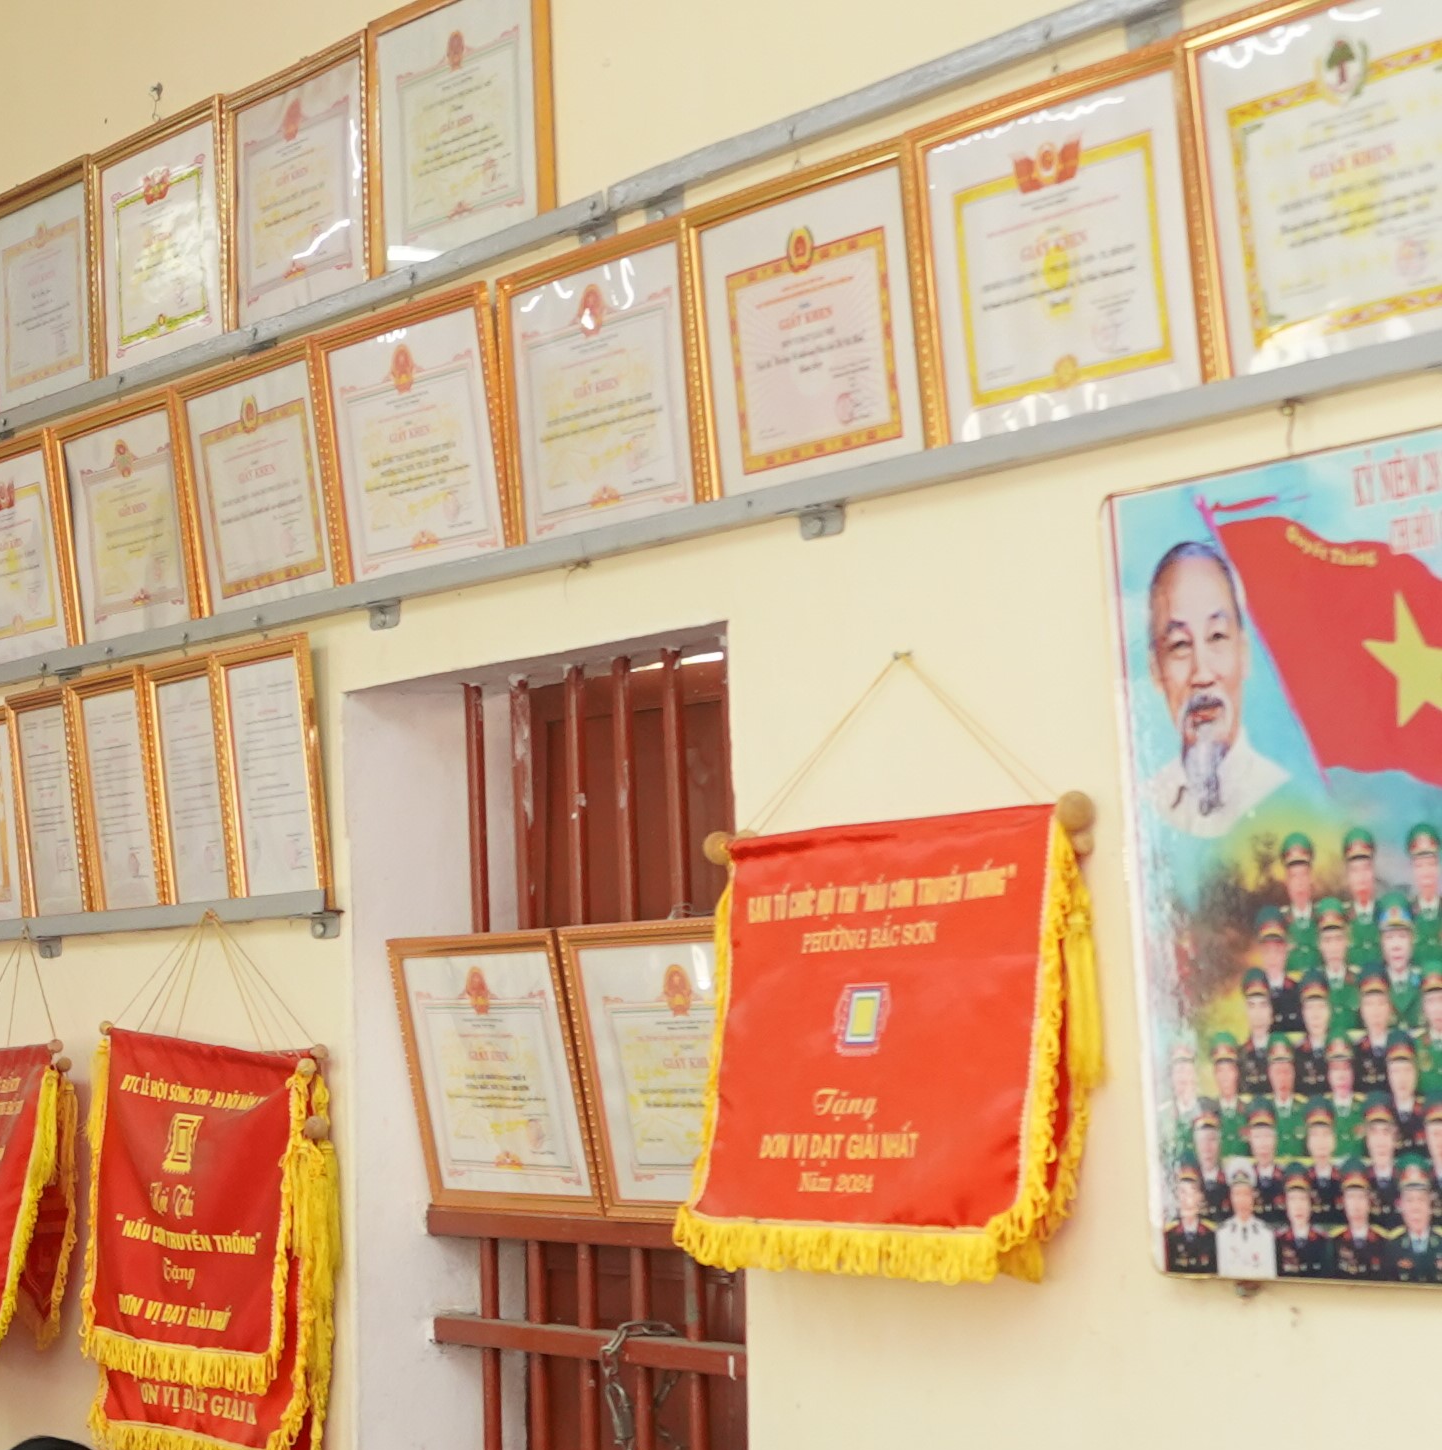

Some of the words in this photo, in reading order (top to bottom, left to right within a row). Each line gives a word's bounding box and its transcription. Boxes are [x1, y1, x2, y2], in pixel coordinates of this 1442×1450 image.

[801, 924, 867, 955] PHƯỜNG
[868, 914, 902, 949] BẮC
[900, 919, 938, 946] SƠN
[812, 1088, 879, 1121] Tặng
[759, 1133, 789, 1159] ĐƠN
[791, 1133, 808, 1167] VỊ
[807, 1132, 841, 1167] ĐẠT
[846, 1123, 877, 1159] GIẢI
[879, 1120, 920, 1159] NHẤT
[797, 1171, 832, 1193] Năm
[834, 1172, 875, 1194] 2024
[163, 1256, 196, 1290] Tặng
[144, 1300, 163, 1326] VỊ
[161, 1303, 187, 1328] ĐẠT
[163, 1386, 181, 1413] VỊ
[210, 1391, 247, 1424] GIẢI
